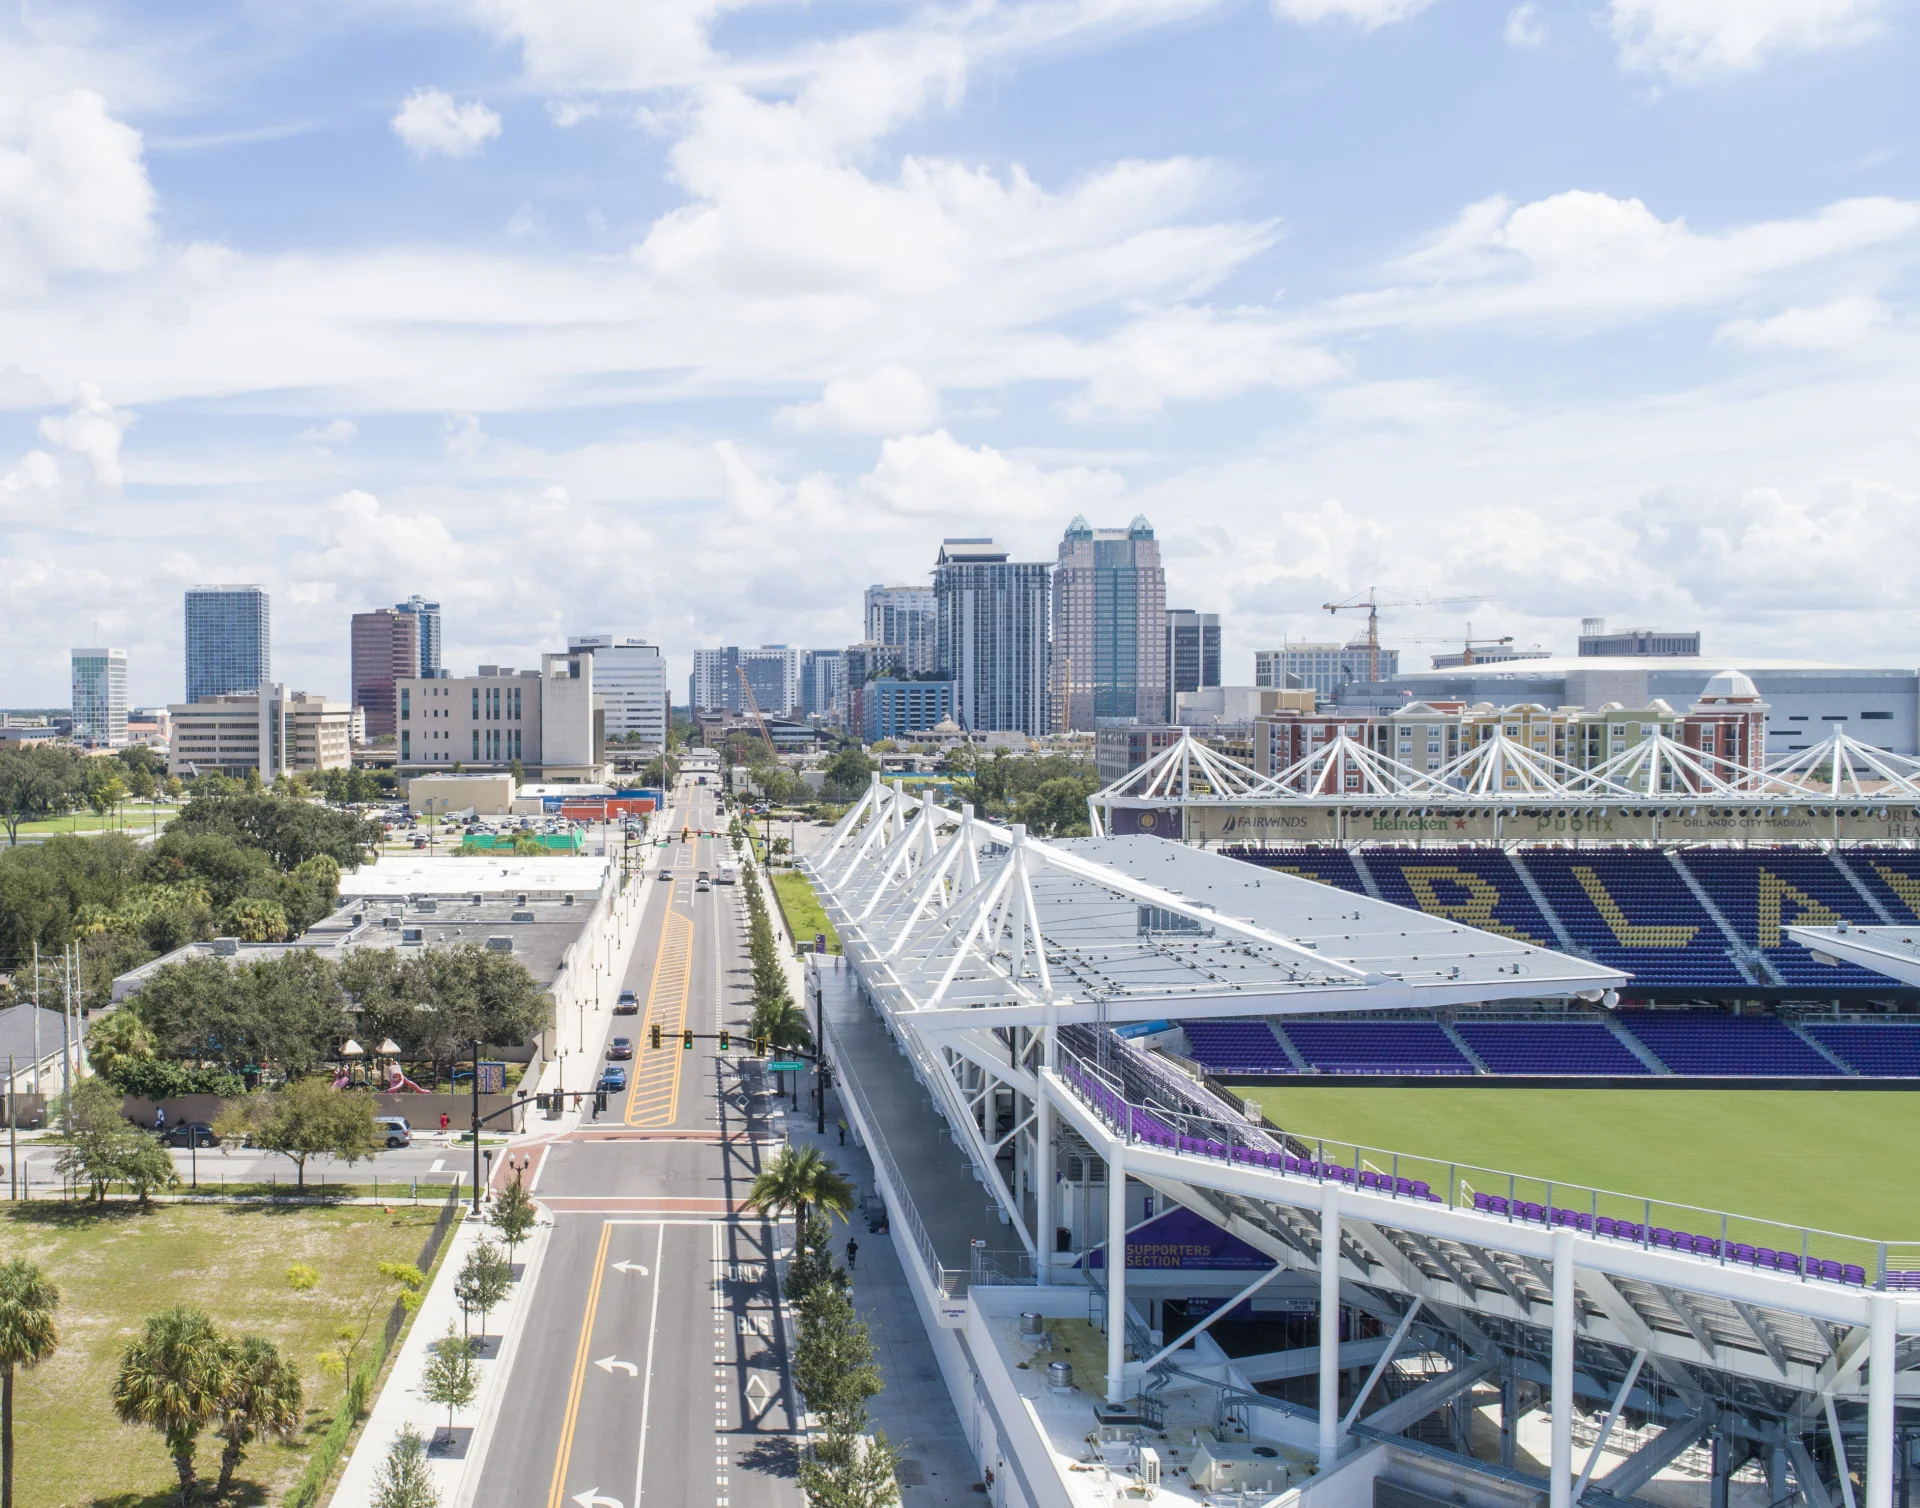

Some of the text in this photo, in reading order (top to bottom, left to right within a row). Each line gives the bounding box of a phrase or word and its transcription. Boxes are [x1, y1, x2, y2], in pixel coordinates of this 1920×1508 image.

[1877, 809, 1920, 822] ORL
[1237, 816, 1308, 828] FAIRWINDS
[1372, 817, 1448, 831] Heineken
[1683, 819, 1812, 828] ORLANDO CITY STADIUM
[1126, 1244, 1211, 1256] SUPPORTERS
[1126, 1255, 1180, 1267] SECTION
[728, 1265, 764, 1283] ONLY
[736, 1315, 769, 1336] BUS
